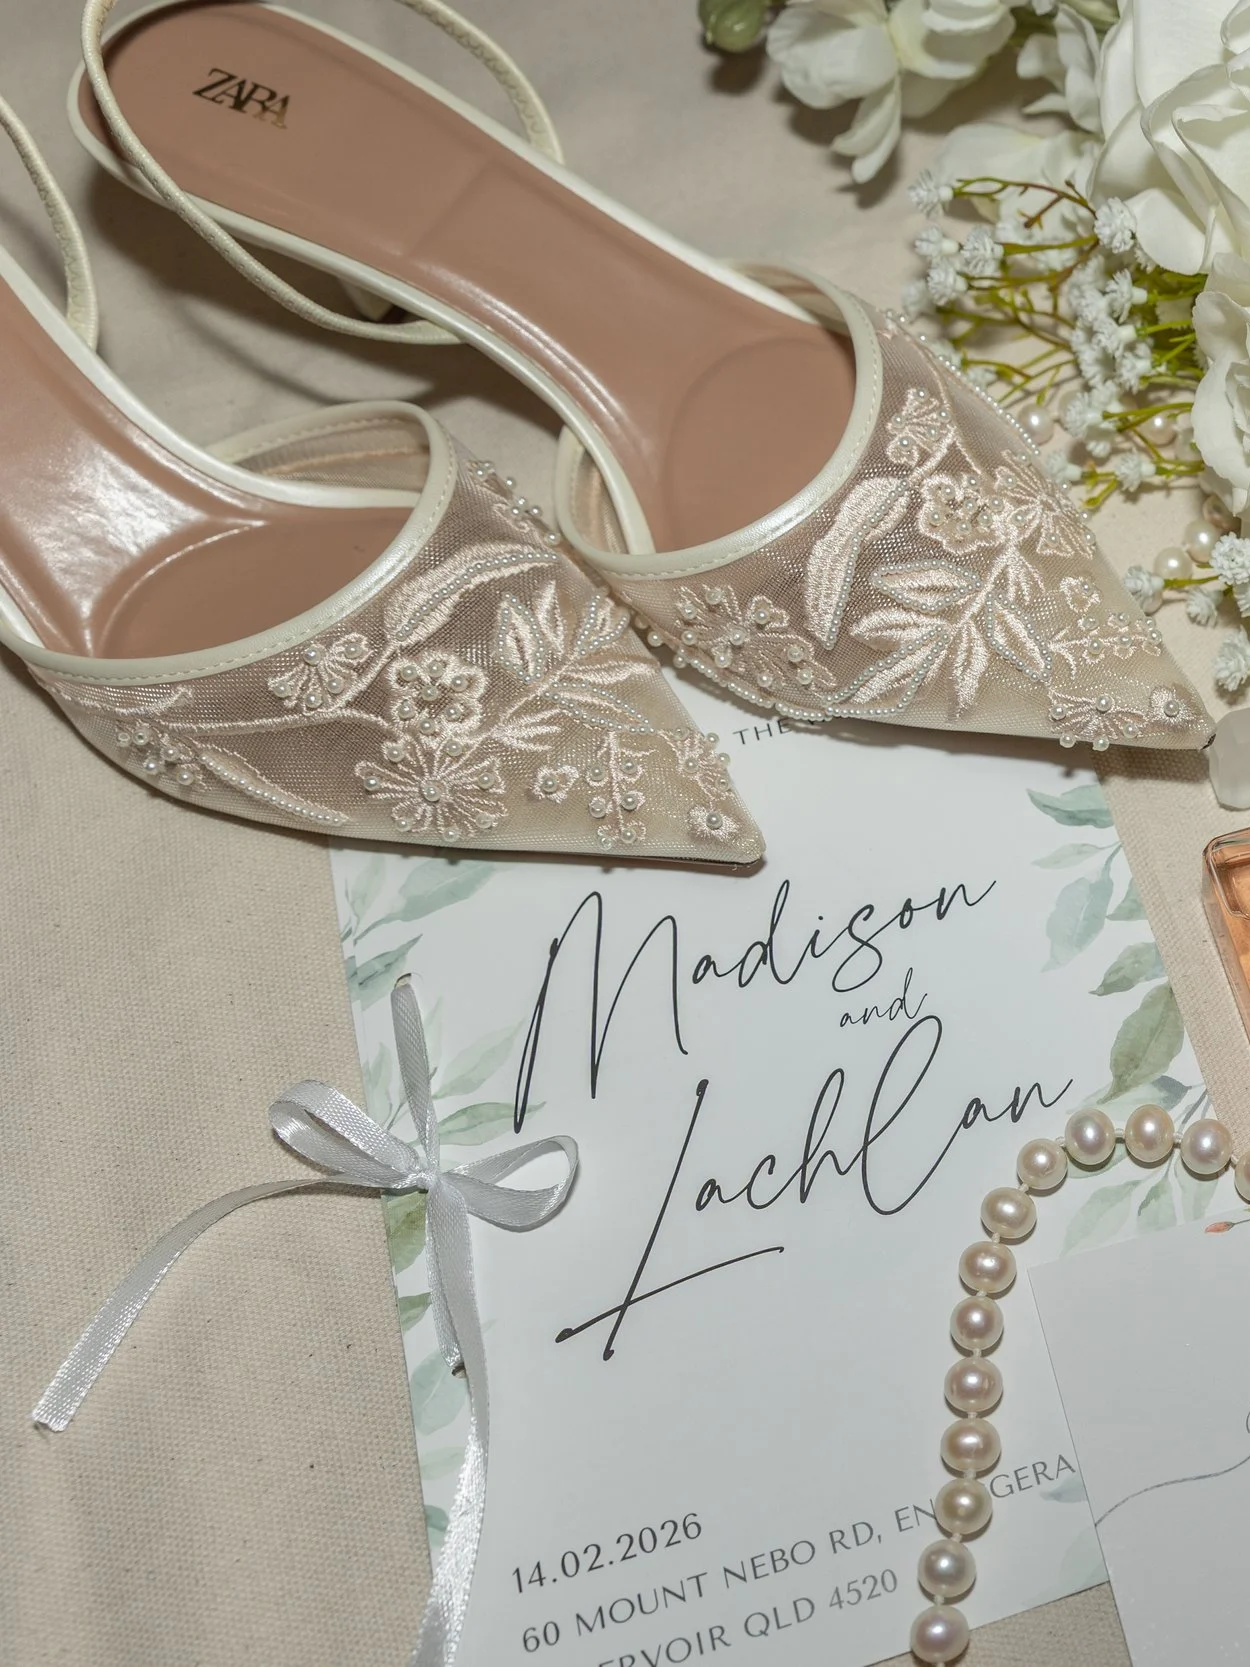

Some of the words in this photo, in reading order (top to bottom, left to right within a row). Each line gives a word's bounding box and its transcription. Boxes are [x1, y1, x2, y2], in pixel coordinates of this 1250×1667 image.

[192, 67, 290, 130] ZARA
[733, 717, 792, 744] THE
[513, 880, 997, 1134] Madison
[839, 967, 927, 1028] and
[555, 1015, 1074, 1361] Lachlan
[511, 1512, 703, 1594] 14.02.2026
[522, 1621, 561, 1653] 60
[575, 1572, 708, 1637] MOUNT
[723, 1539, 816, 1590] NEBO
[828, 1520, 883, 1555] RD,
[894, 1454, 1076, 1533] ENGERA
[743, 1596, 816, 1638] QLD
[828, 1568, 898, 1610] 4520
